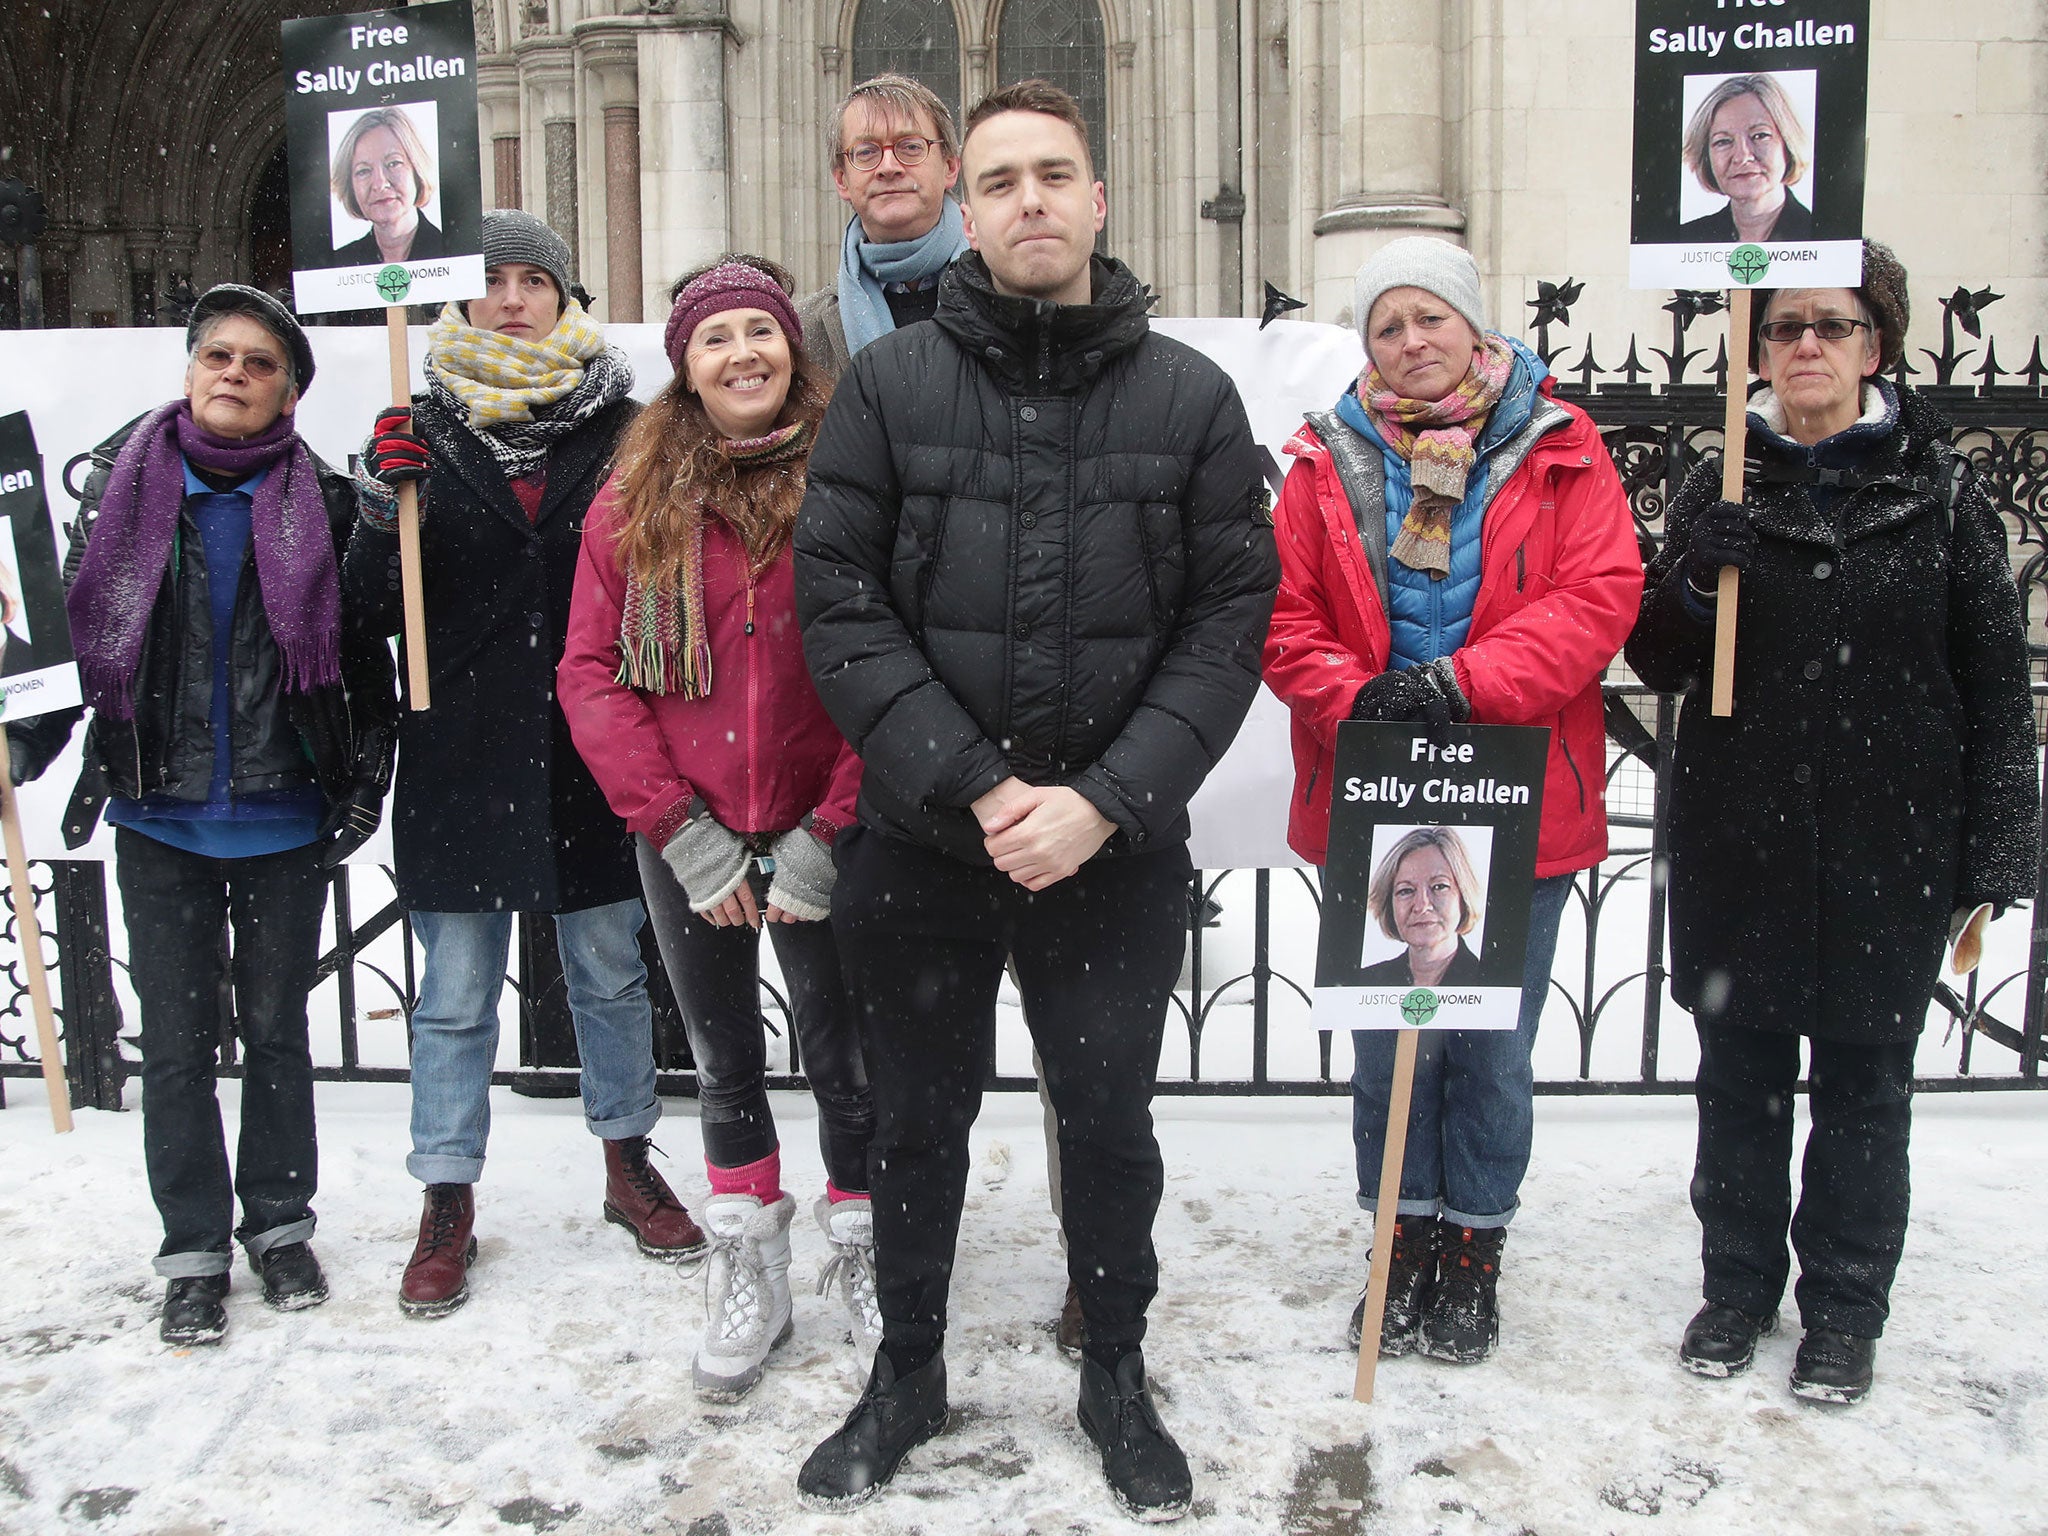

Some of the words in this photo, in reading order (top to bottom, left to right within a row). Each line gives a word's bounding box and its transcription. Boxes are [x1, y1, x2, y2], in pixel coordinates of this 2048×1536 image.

[351, 25, 409, 50] Free
[1648, 25, 1726, 57] Sally
[1733, 20, 1854, 49] Challen
[295, 65, 362, 95] Sally
[366, 55, 466, 87] Challen
[1680, 251, 1732, 263] JUSTICE
[1735, 250, 1763, 262] FOR
[1767, 250, 1818, 261] WOMEN
[336, 272, 380, 287] JUSTICE
[382, 271, 406, 282] FOR
[408, 266, 451, 280] WOMEN
[3, 678, 45, 696] WOMEN
[1410, 737, 1474, 763] Free
[1343, 776, 1417, 808] Sally
[1422, 778, 1530, 805] Challen
[1358, 994, 1406, 1005] JUSTICE
[1408, 993, 1433, 1006] FOR
[1437, 994, 1483, 1005] WOMEN
